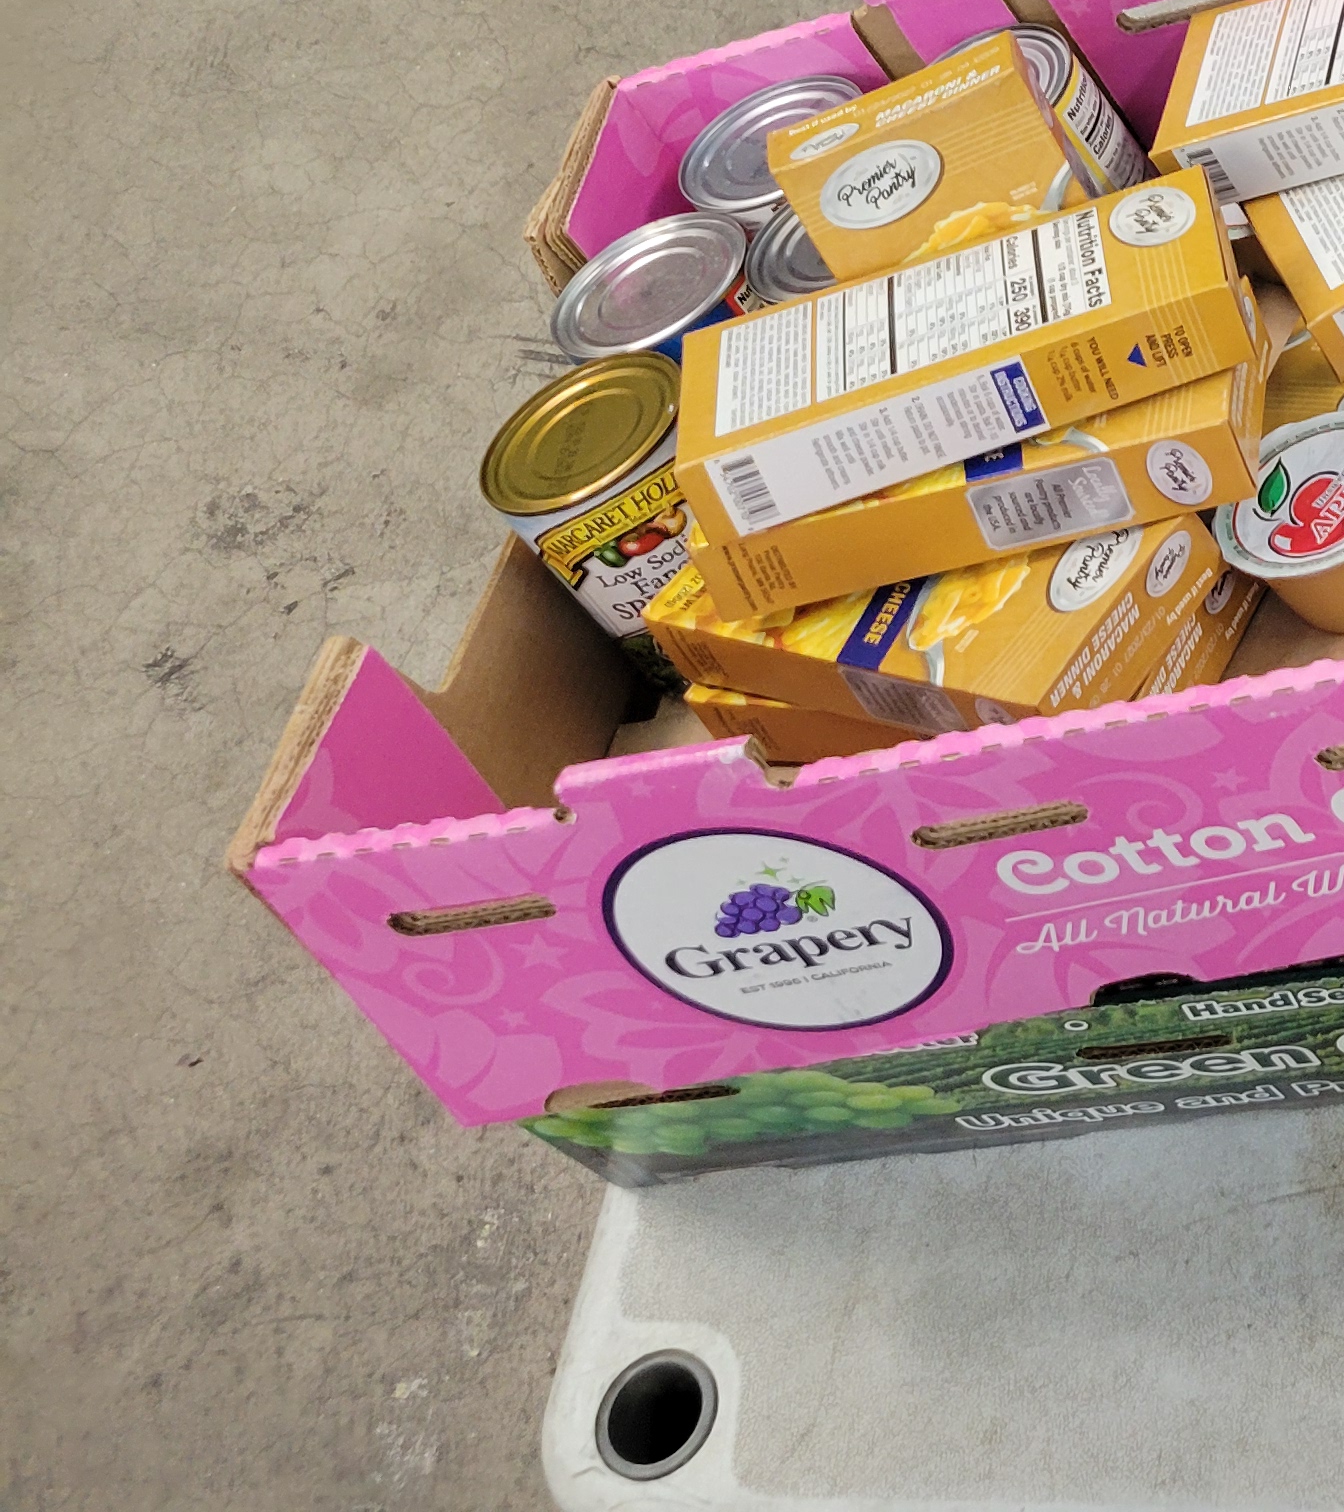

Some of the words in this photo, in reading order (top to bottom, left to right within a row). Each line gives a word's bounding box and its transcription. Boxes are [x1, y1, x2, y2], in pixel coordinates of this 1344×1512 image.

[876, 76, 963, 120] MACARONI
[942, 65, 1001, 99] DINNER
[837, 158, 897, 206] Premier
[866, 166, 916, 210] Pantry
[1126, 208, 1160, 236] Pantry
[1140, 193, 1175, 224] Premier
[1005, 236, 1018, 269] Calories
[1075, 209, 1099, 268] Nutrition
[1010, 277, 1029, 303] 250
[1084, 266, 1104, 309] Facts
[1013, 307, 1032, 332] 390
[1174, 324, 1183, 336] TO
[1145, 334, 1158, 351] AND
[1151, 350, 1168, 368] LIFT
[1161, 333, 1179, 359] PRESS
[1178, 336, 1194, 358] OPEN
[1086, 336, 1101, 356] YOU
[1095, 356, 1110, 380] WILL
[1103, 379, 1119, 401] NEED
[1158, 462, 1188, 492] Pantry
[1165, 448, 1197, 483] Premier
[548, 503, 633, 556] MARGARET
[1066, 542, 1105, 592] Pantry
[1094, 527, 1130, 584] Premier
[597, 566, 644, 589] Low
[863, 582, 912, 647] CHEESE
[1091, 591, 1134, 652] CHEESE
[1082, 604, 1141, 686] MACARONI
[1049, 648, 1092, 709] DINNER
[1072, 686, 1082, 700] &
[996, 800, 1316, 894] Cotton
[1016, 916, 1098, 956] All
[1122, 883, 1288, 938] Natural
[664, 916, 913, 979] Grapery
[740, 984, 767, 995] EST
[811, 960, 893, 982] CALIFORNIA
[1182, 988, 1299, 1022] Hand
[982, 1043, 1324, 1096] Green
[954, 1097, 1166, 1132] Unique
[1174, 1080, 1287, 1111] and
